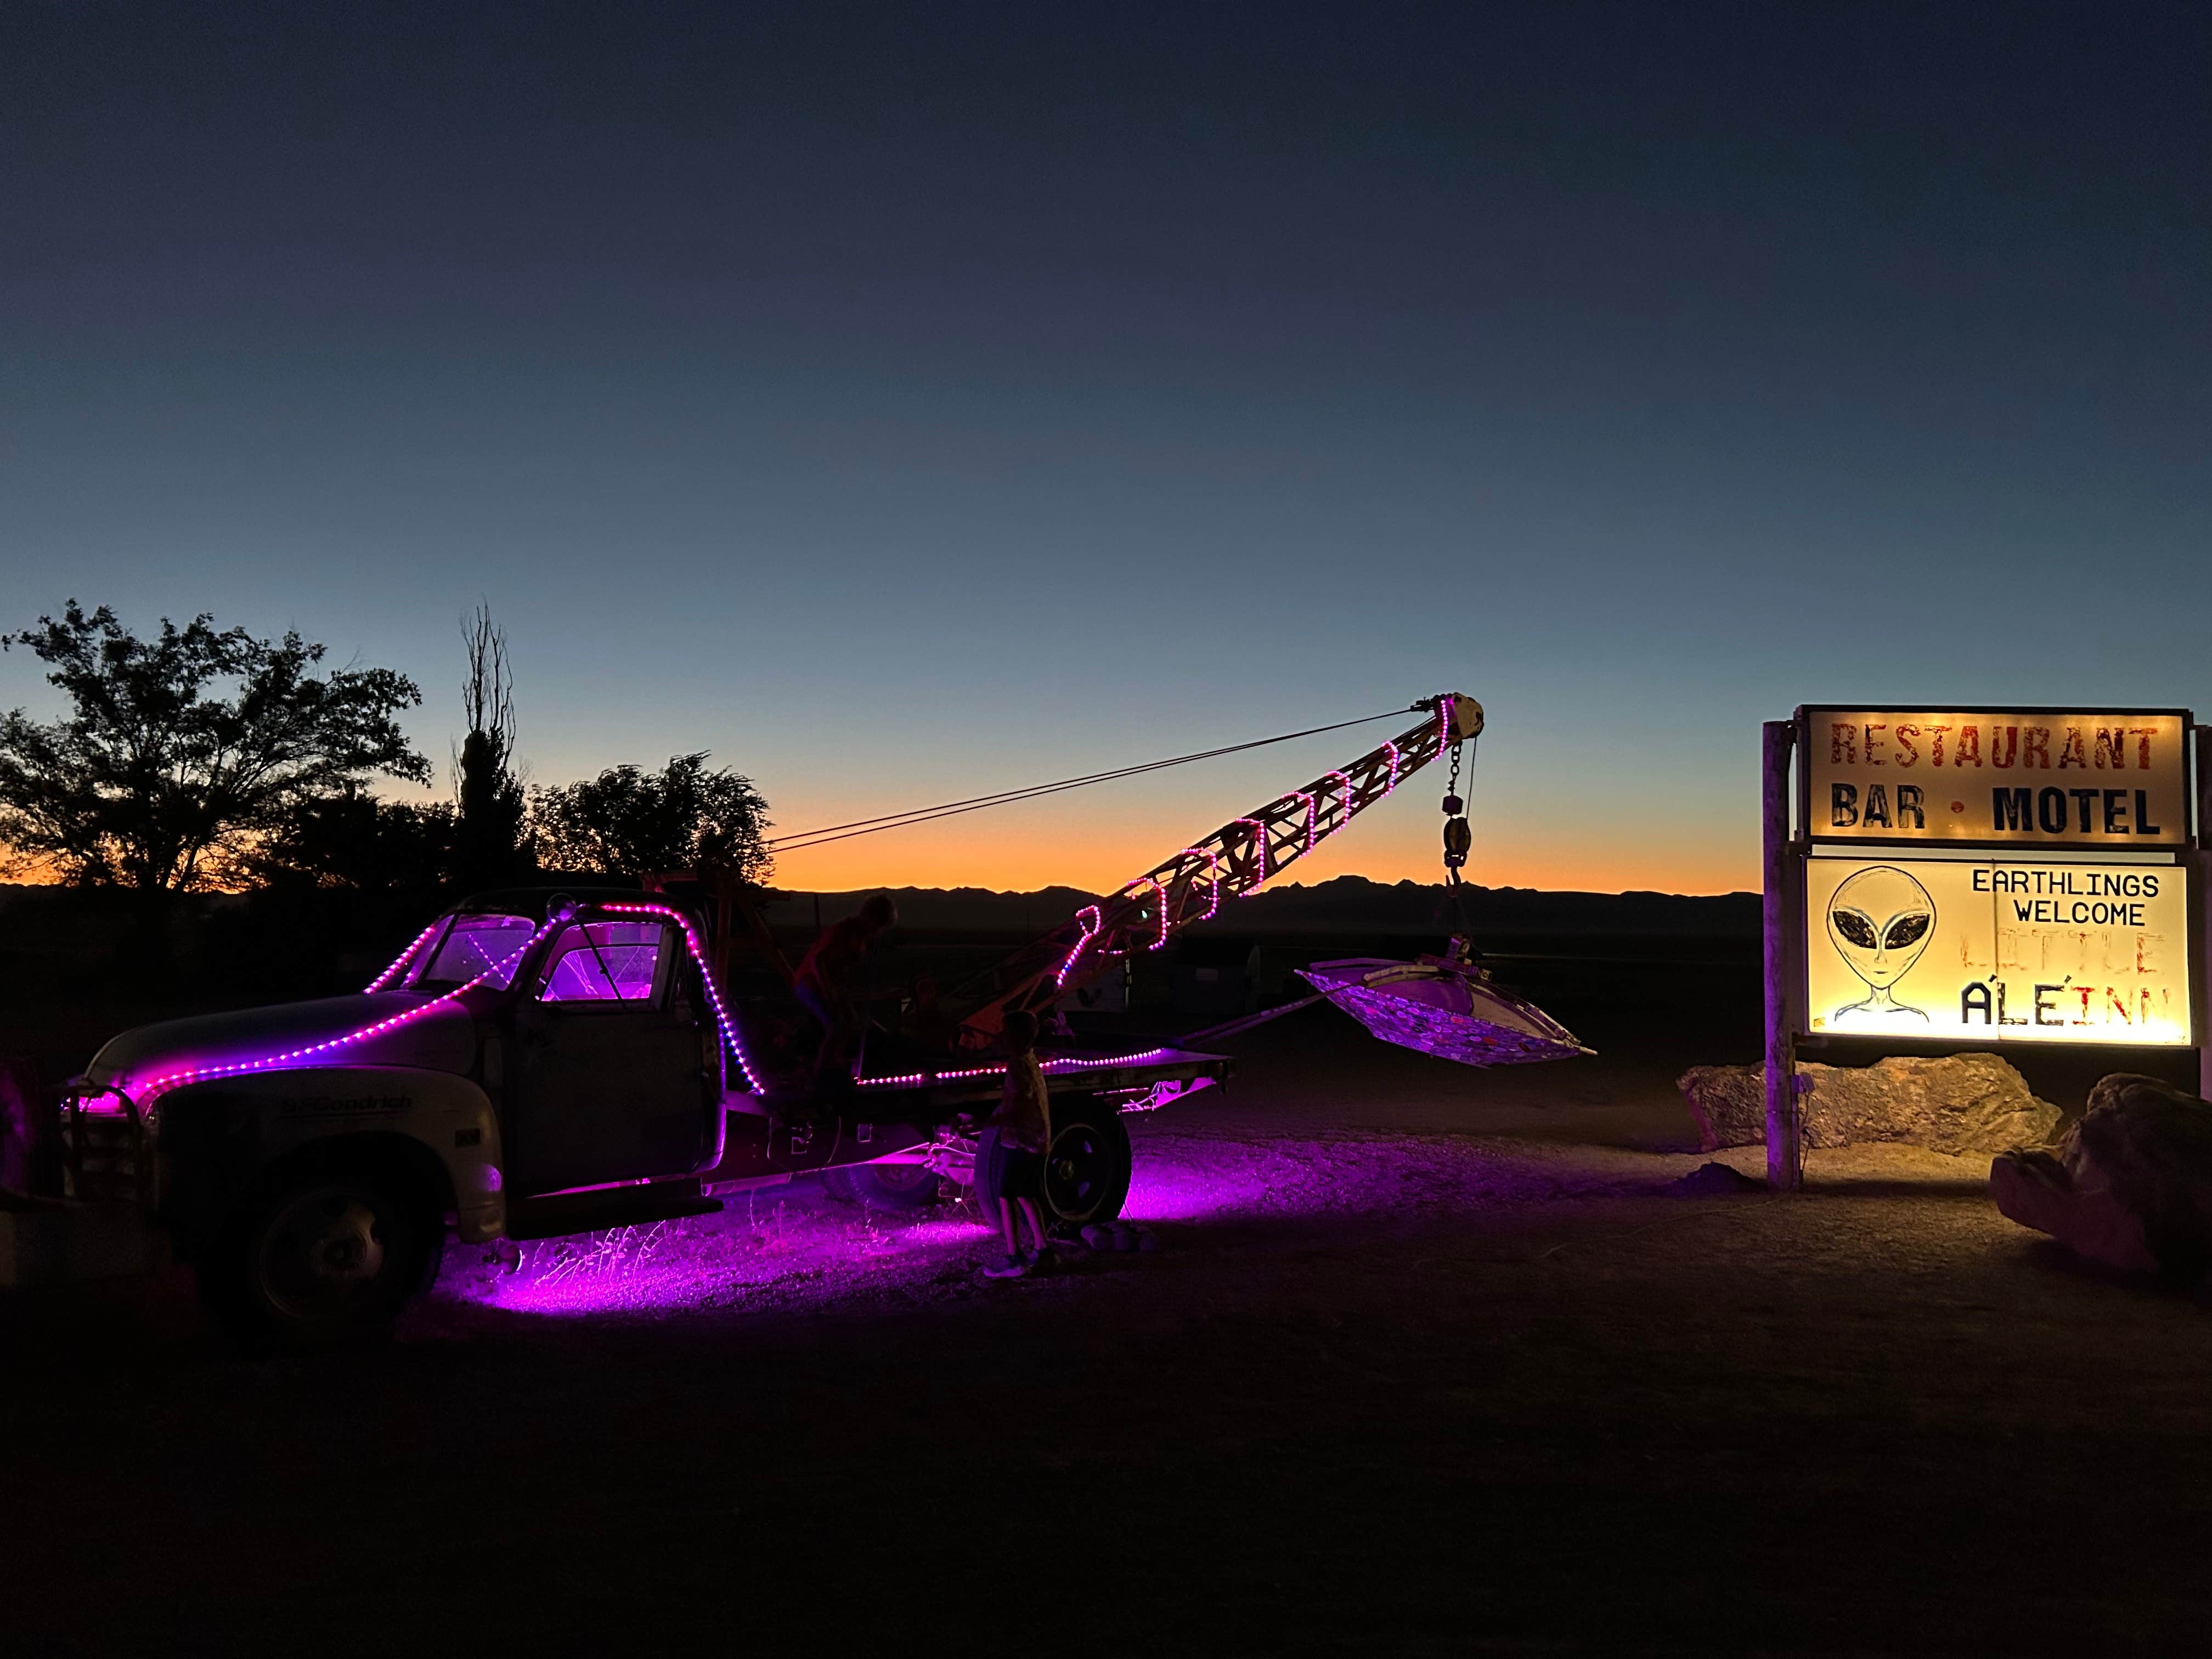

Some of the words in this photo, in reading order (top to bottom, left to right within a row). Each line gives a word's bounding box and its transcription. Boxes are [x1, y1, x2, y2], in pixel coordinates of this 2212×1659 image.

[1831, 723, 2158, 769] RESTAURANT
[1831, 783, 1925, 828] BAR
[1992, 786, 2160, 834] MOTEL
[1973, 870, 2159, 898] EARTHLINGS
[2013, 900, 2146, 926] WELCOME
